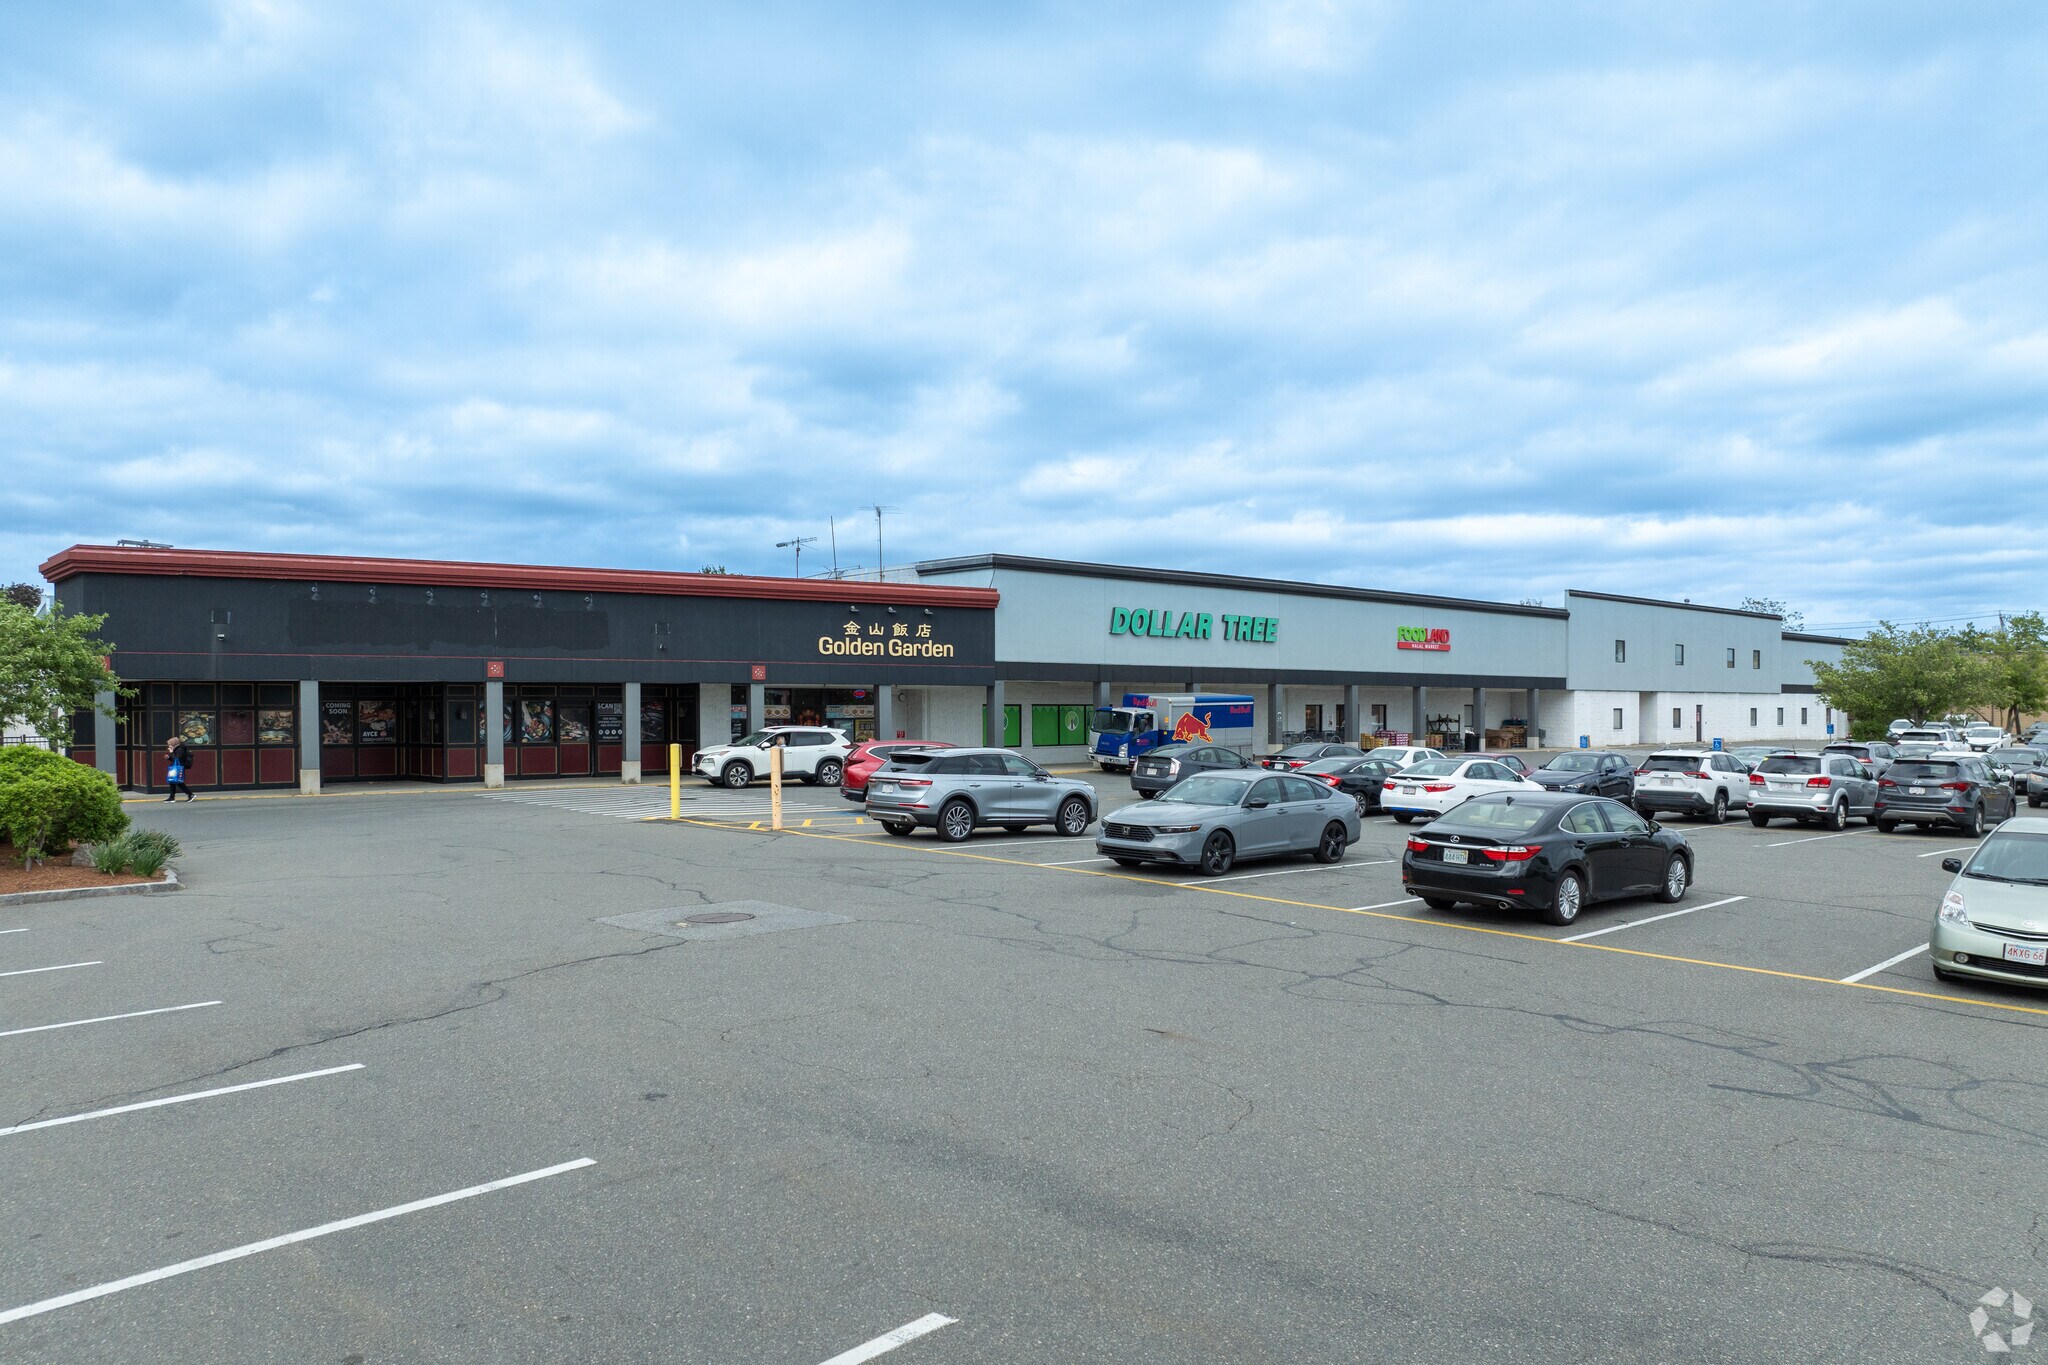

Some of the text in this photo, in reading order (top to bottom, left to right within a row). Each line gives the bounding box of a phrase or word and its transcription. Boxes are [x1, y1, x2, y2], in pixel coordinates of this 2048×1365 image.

[843, 620, 932, 638] 金山飯店
[1109, 606, 1280, 643] DOLLAR TREE
[1397, 626, 1450, 643] FOODLAND
[818, 636, 954, 658] Golden Garden
[1132, 697, 1157, 708] Red Bull
